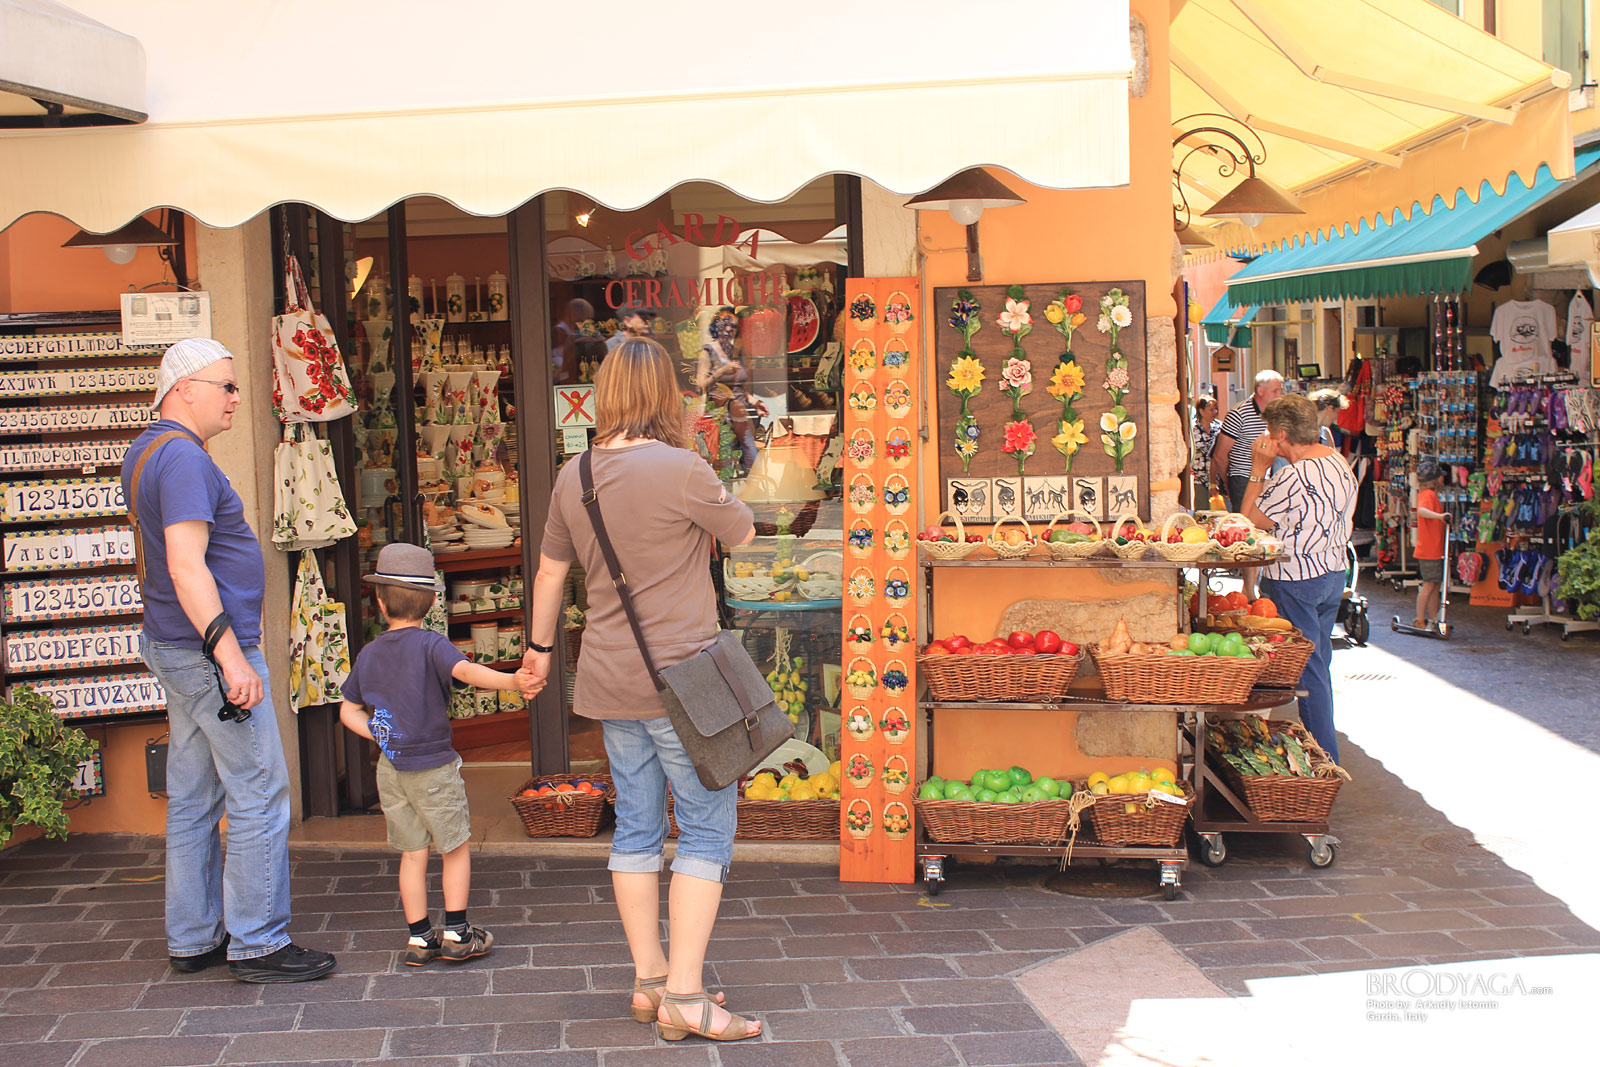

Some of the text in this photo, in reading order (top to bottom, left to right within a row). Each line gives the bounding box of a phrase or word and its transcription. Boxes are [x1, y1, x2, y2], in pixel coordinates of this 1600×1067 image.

[625, 213, 760, 260] GARDA
[605, 274, 789, 310] CERAMICHE
[69, 372, 157, 388] 123456789
[15, 486, 127, 513] 12345678
